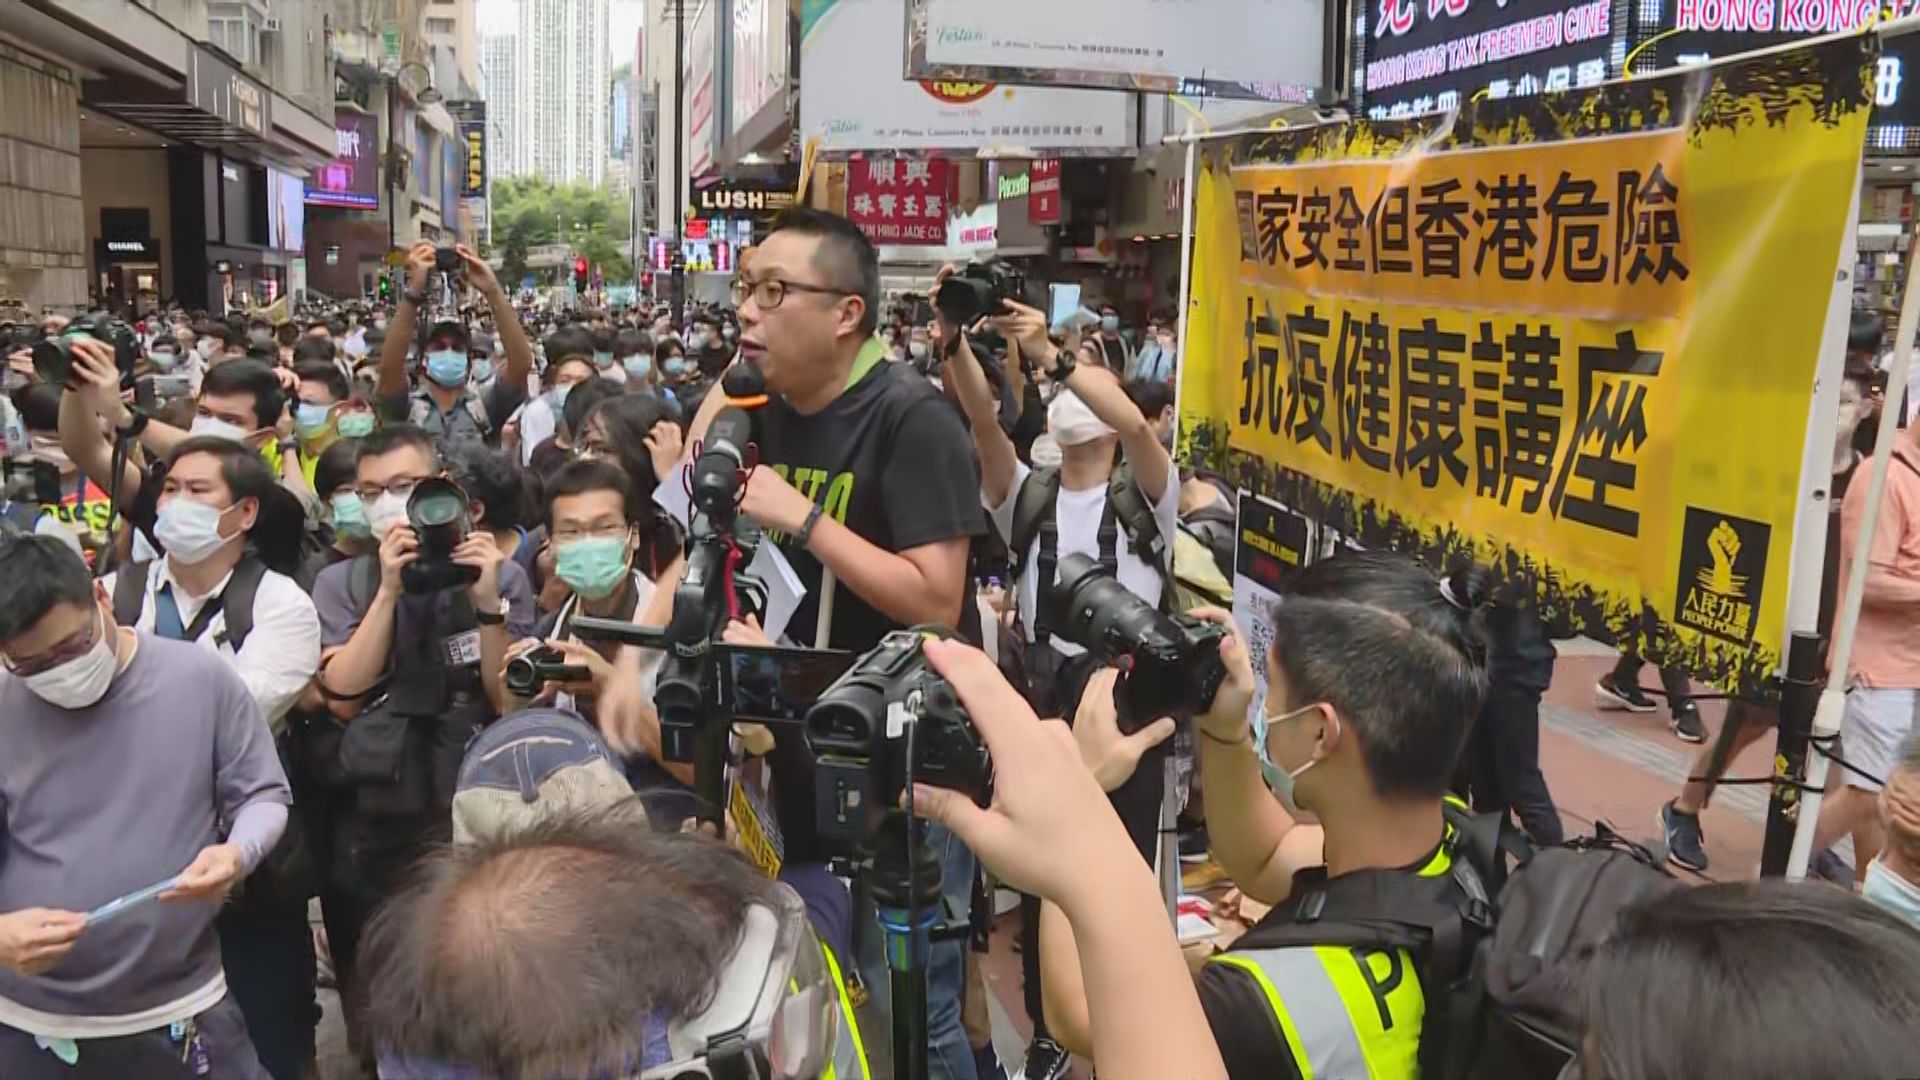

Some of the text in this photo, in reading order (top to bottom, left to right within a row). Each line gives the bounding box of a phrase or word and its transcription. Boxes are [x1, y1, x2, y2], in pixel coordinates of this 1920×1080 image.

[1677, 0, 1777, 32] HONG
[1367, 54, 1404, 91] HONG
[1405, 44, 1445, 82] KONG
[1449, 34, 1478, 70] TAX
[869, 159, 931, 187] 順興
[702, 190, 763, 209] LUSH
[903, 225, 927, 240] JADE
[1235, 162, 1690, 285] 國家安全但香港危險
[107, 241, 145, 252] CHANEL
[1239, 297, 1664, 539] 抗疫健康講座
[1350, 946, 1403, 1031] P
